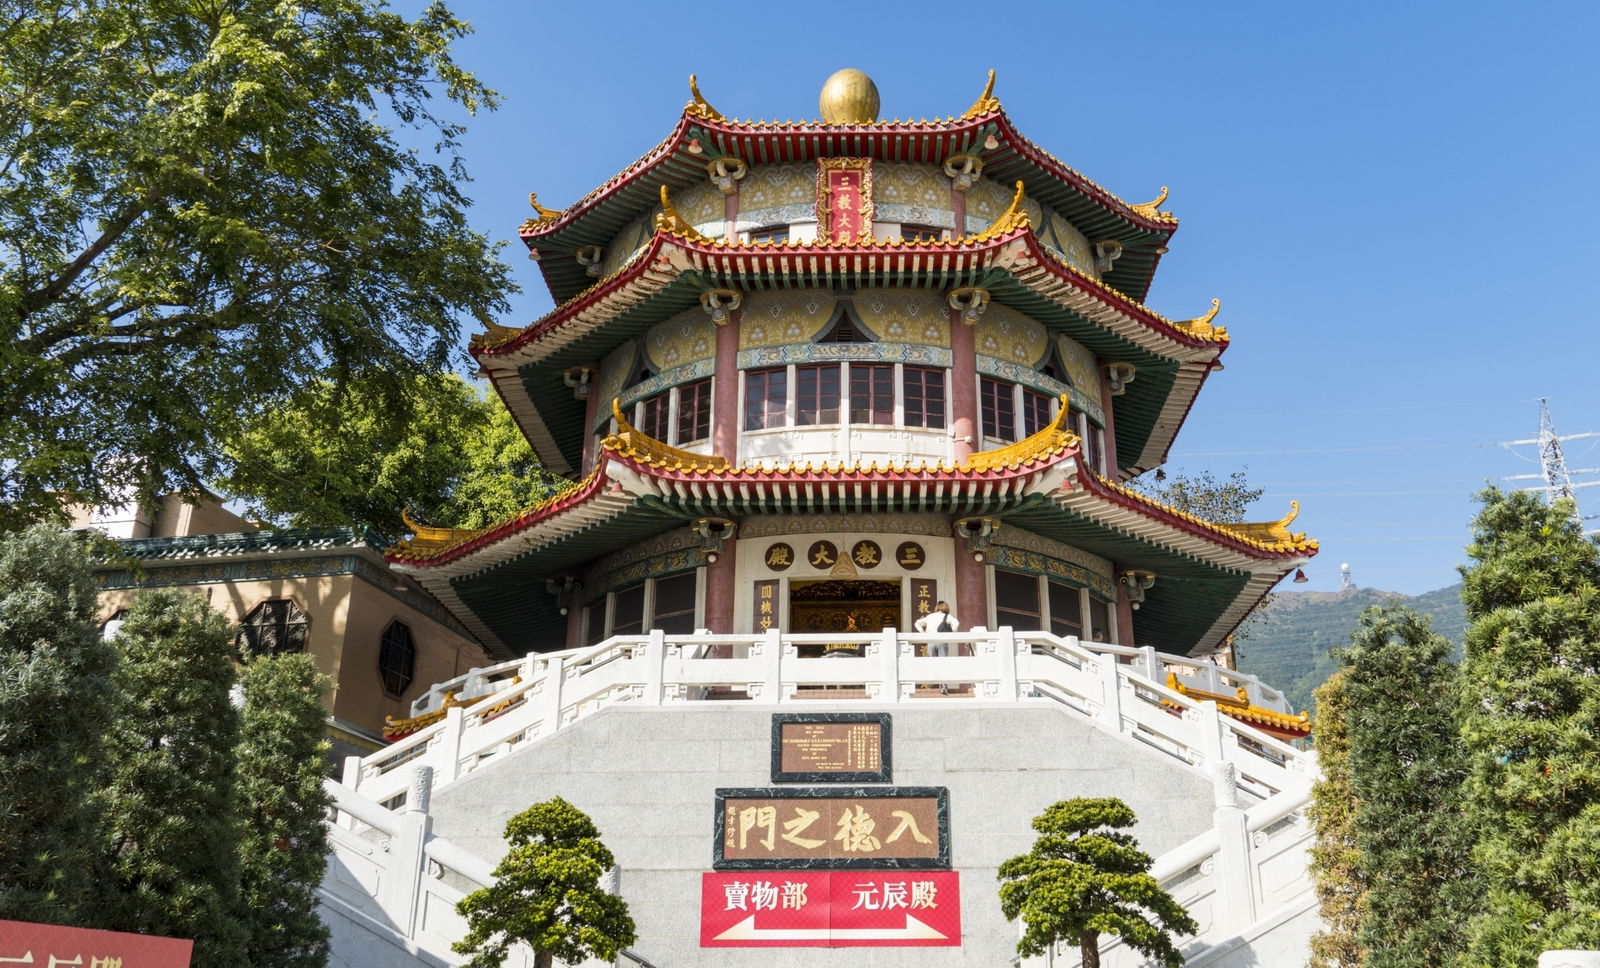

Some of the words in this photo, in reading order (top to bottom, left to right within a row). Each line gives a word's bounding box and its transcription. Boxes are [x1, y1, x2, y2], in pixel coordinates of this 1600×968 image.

[767, 543, 921, 566] 三教大殿
[760, 585, 773, 634] 圓機妙
[918, 585, 931, 619] 正教
[739, 804, 932, 852] 入德之門
[723, 881, 809, 911] 賣物部
[851, 880, 939, 910] 元辰殿
